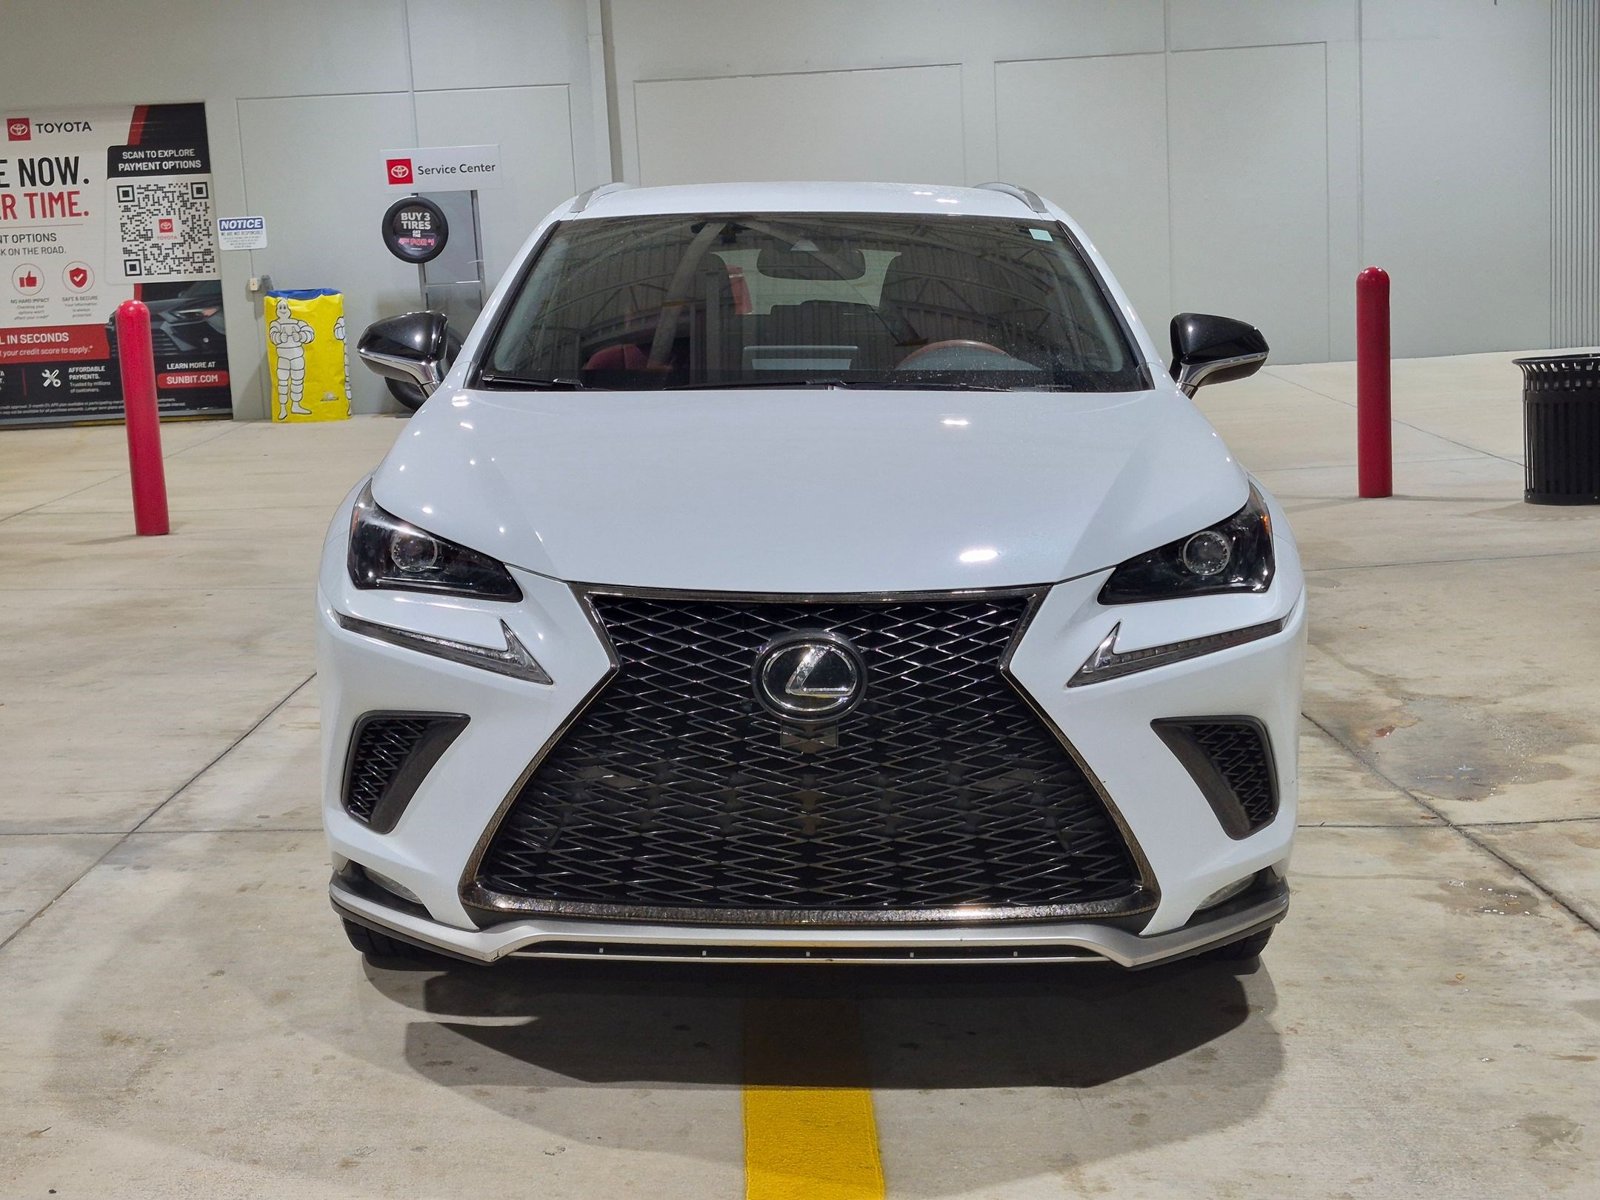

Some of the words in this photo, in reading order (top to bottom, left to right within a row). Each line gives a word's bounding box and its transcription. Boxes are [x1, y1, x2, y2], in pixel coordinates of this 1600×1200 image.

[35, 121, 92, 133] TOYOTA
[122, 151, 144, 160] SCAN
[146, 150, 157, 158] TO
[158, 148, 196, 158] EXPLORE
[118, 161, 161, 171] PAYMENT
[162, 160, 202, 170] OPTIONS
[417, 164, 456, 175] Service
[459, 163, 496, 173] Center
[18, 156, 90, 187] NOW.
[0, 193, 18, 220] R
[23, 191, 89, 219] TIME.
[401, 212, 422, 220] BUY
[424, 212, 431, 221] 3
[221, 219, 262, 229] NOTICE
[401, 220, 431, 230] TIRES
[11, 232, 57, 243] OPTIONS
[8, 248, 20, 256] ON
[22, 246, 39, 255] THE
[41, 245, 67, 255] ROAD.
[7, 335, 18, 344] IN
[20, 332, 69, 344] SECONDS
[3, 350, 18, 358] your
[19, 348, 40, 356] credit
[166, 374, 218, 385] SUNBIT.COM
